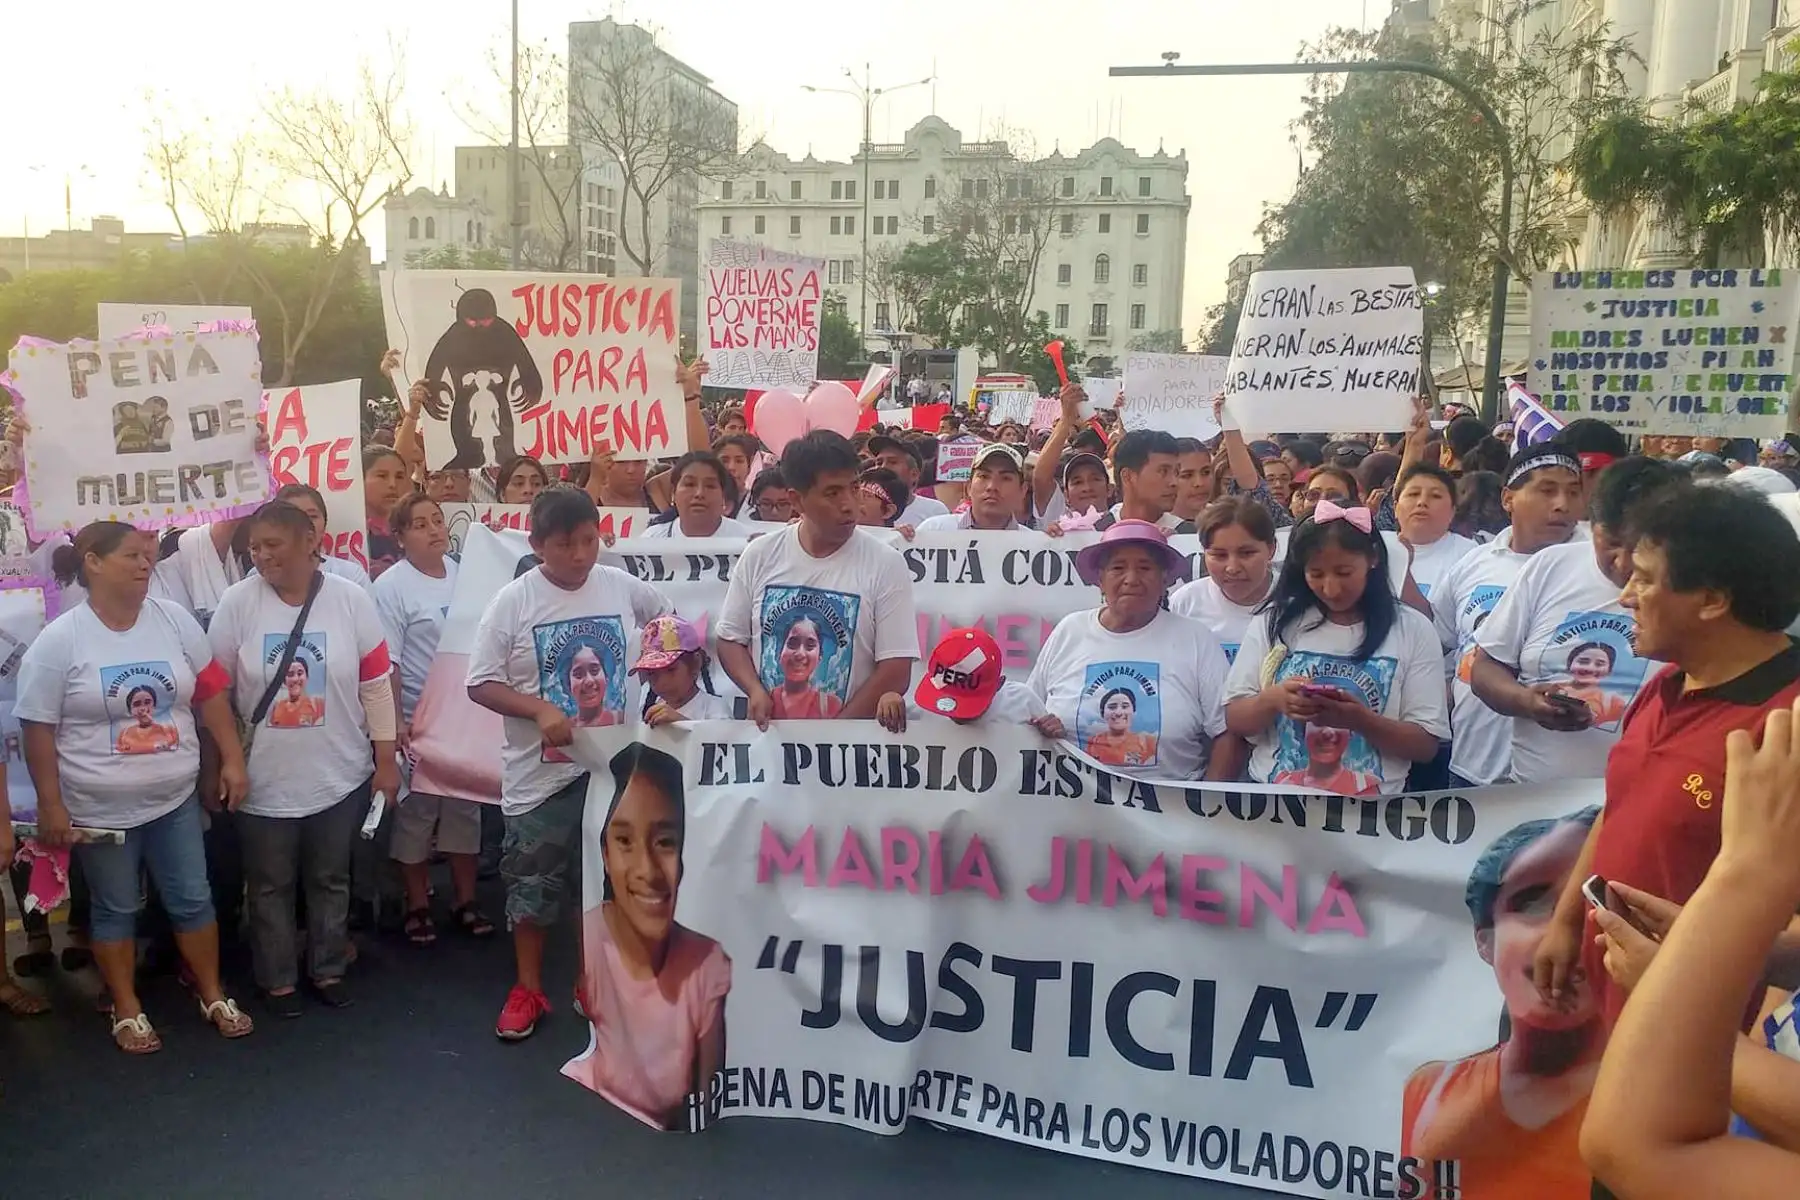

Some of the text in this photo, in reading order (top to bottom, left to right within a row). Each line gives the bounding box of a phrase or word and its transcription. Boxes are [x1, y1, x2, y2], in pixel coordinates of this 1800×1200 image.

[709, 268, 819, 298] VUELVAS A
[1553, 269, 1781, 289] LUCHEMOS POR LA
[512, 282, 676, 343] JUSTICIA
[707, 296, 817, 327] PONERME
[1318, 297, 1344, 316] LAS
[1351, 284, 1422, 315] BESTIAS
[1600, 298, 1719, 320] JUSTICIA
[710, 324, 818, 351] LAS MANOS
[1309, 338, 1336, 356] LOS
[1340, 334, 1422, 356] ANIMALES
[1551, 329, 1642, 348] MADRES
[1662, 326, 1759, 346] LUCHEN
[67, 344, 220, 399] PENA
[552, 346, 648, 396] PARA
[1551, 351, 1668, 370] NOSOTROS
[1342, 367, 1419, 392] MUERAN
[1552, 374, 1579, 391] LA
[1593, 374, 1653, 392] PENA
[1591, 396, 1630, 412] LOS
[188, 399, 245, 441] DE
[520, 399, 670, 460] JIMENA
[76, 460, 260, 506] MUERTE
[621, 555, 675, 581] EL
[903, 540, 985, 584] STÁ
[763, 594, 848, 649] JUSTICIA PARA JIMENA
[1555, 619, 1628, 645] JUSTICIA PARA
[544, 631, 573, 674] JUSTICIA
[572, 623, 597, 639] PARA
[108, 670, 131, 698] JUSTICIA
[130, 667, 150, 675] PARA
[934, 663, 981, 690] PERU
[1087, 666, 1157, 697] JUSTICIA PARA JIMENA
[1323, 663, 1354, 679] PARA
[699, 743, 765, 786] EL
[781, 743, 999, 793] PUEBLO
[1184, 788, 1477, 845] CONTIGO
[756, 820, 1370, 939] MARIA JIMENA
[802, 1069, 845, 1115] DE
[854, 1069, 973, 1127] MURTE
[977, 1083, 1071, 1143] PARA
[1081, 1104, 1153, 1156] LOS
[1161, 1116, 1421, 1199] VIOLADORES
